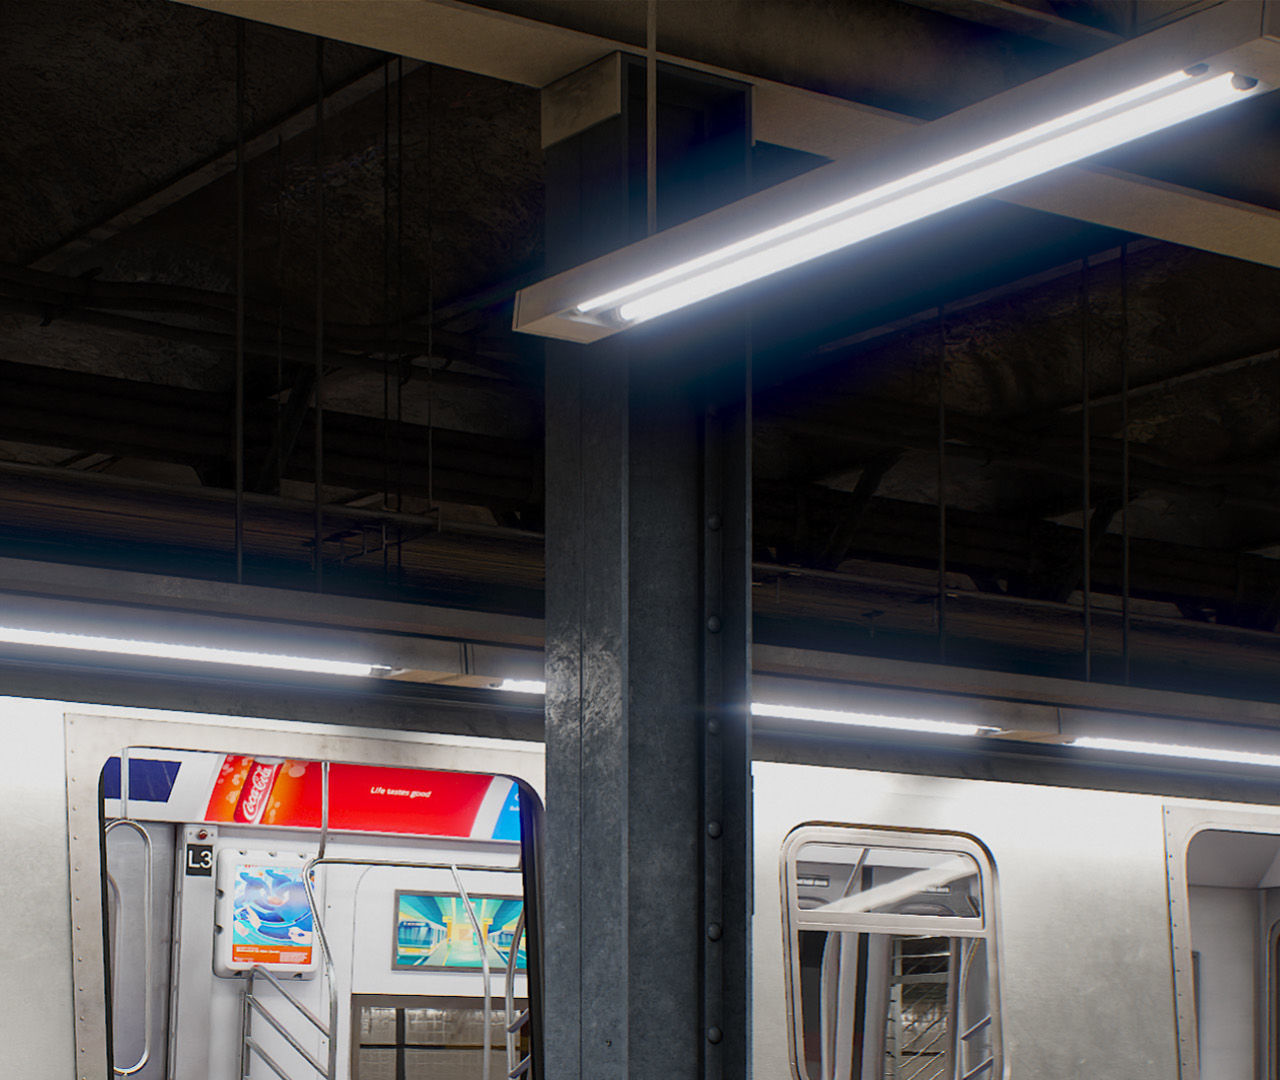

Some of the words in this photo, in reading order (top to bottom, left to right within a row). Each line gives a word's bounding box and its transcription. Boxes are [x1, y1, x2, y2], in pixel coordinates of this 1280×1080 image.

[370, 786, 386, 795] Life
[386, 788, 410, 797] tastes
[410, 790, 433, 799] good
[188, 849, 212, 869] L3
